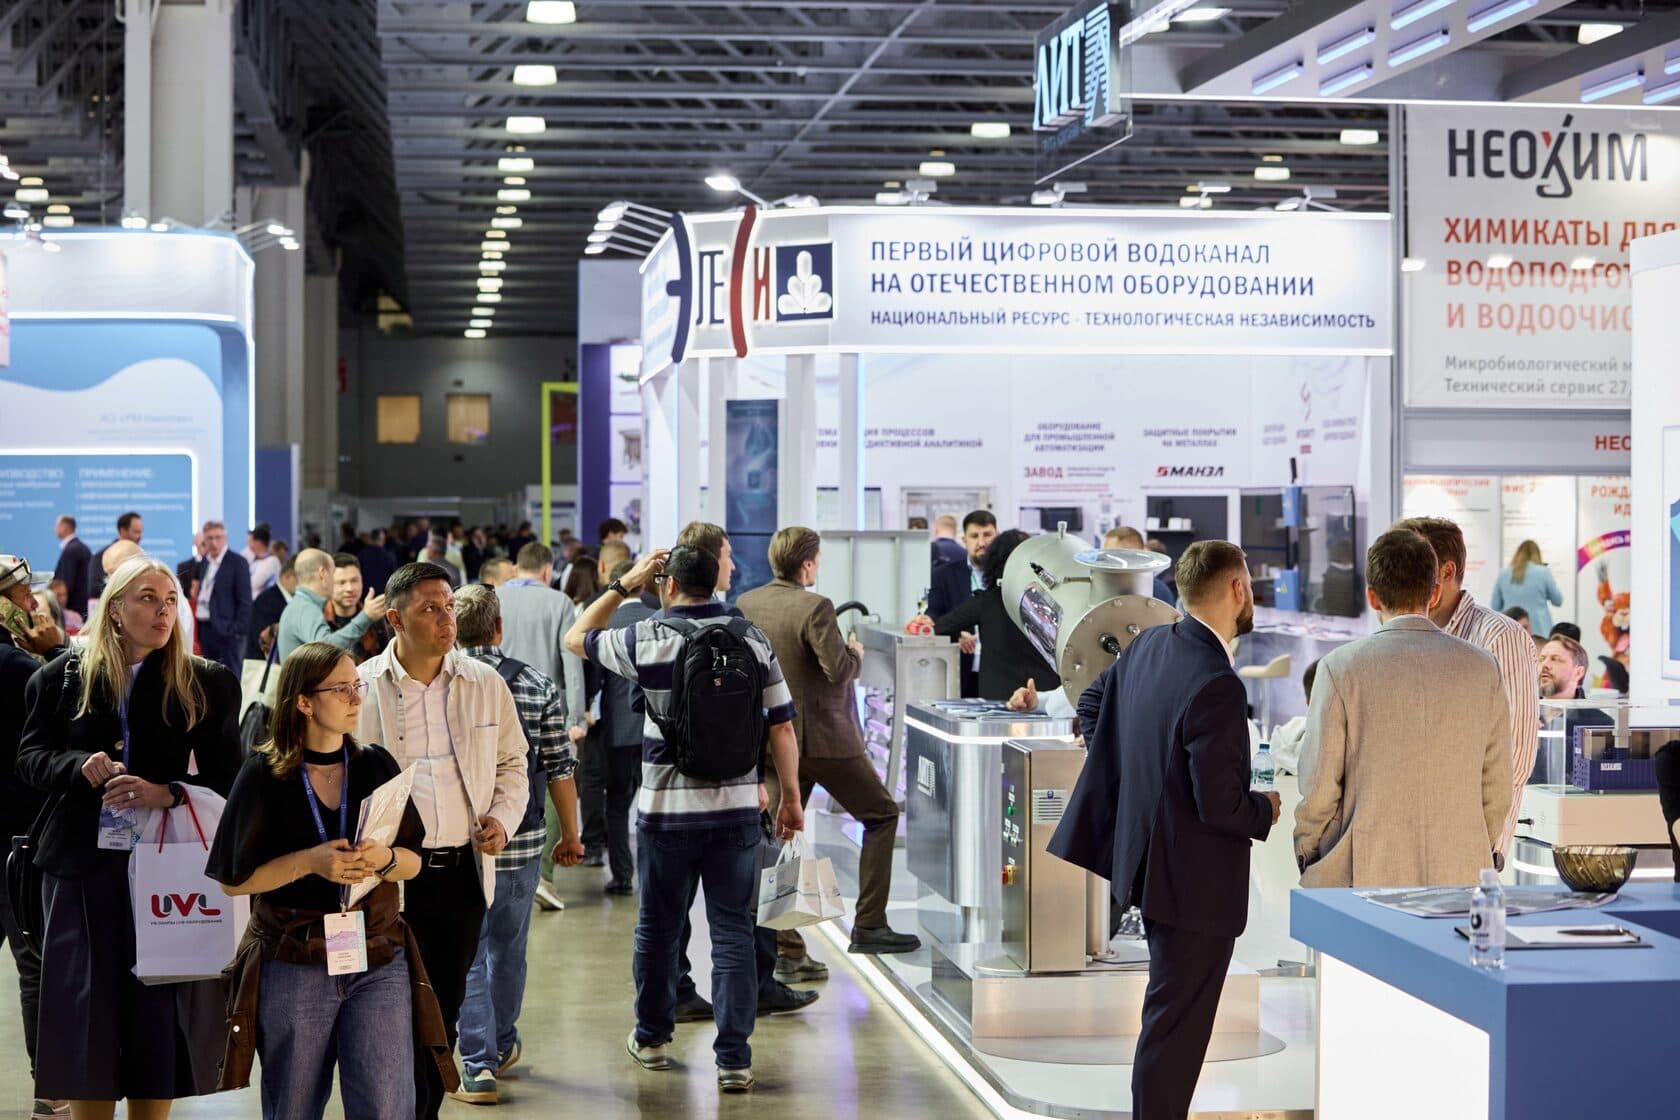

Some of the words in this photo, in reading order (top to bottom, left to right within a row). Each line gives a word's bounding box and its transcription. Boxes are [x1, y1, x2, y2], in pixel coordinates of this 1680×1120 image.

[1447, 113, 1648, 198] НЕОХИМ
[1444, 217, 1609, 246] ХИМИКАТЫ
[871, 236, 972, 261] ПЕРВЫЙ
[983, 237, 1118, 266] ЦИФРОВОЙ
[1128, 242, 1270, 267] ВОДОКАНАЛ
[871, 273, 900, 293] НА
[910, 273, 1113, 294] ОТЕЧЕСТВЕННОМ
[1123, 275, 1315, 298] ОБОРУДОВАНИИ
[871, 307, 1006, 326] НАЦИОНАЛЬНЫЙ
[1012, 311, 1070, 326] РЕСУРС
[1085, 311, 1234, 327] ТЕХНОЛОГИЧЕСКАЯ
[1240, 313, 1375, 329] НЕЗАВИСИМОСТЬ
[1447, 303, 1465, 328] И
[1445, 355, 1617, 374] Микробиологический
[1444, 377, 1545, 393] Технический
[1550, 382, 1604, 397] сервис
[1024, 467, 1063, 478] ЗАВОД
[1591, 486, 1632, 499] РОЖД
[151, 893, 221, 918] UVL
